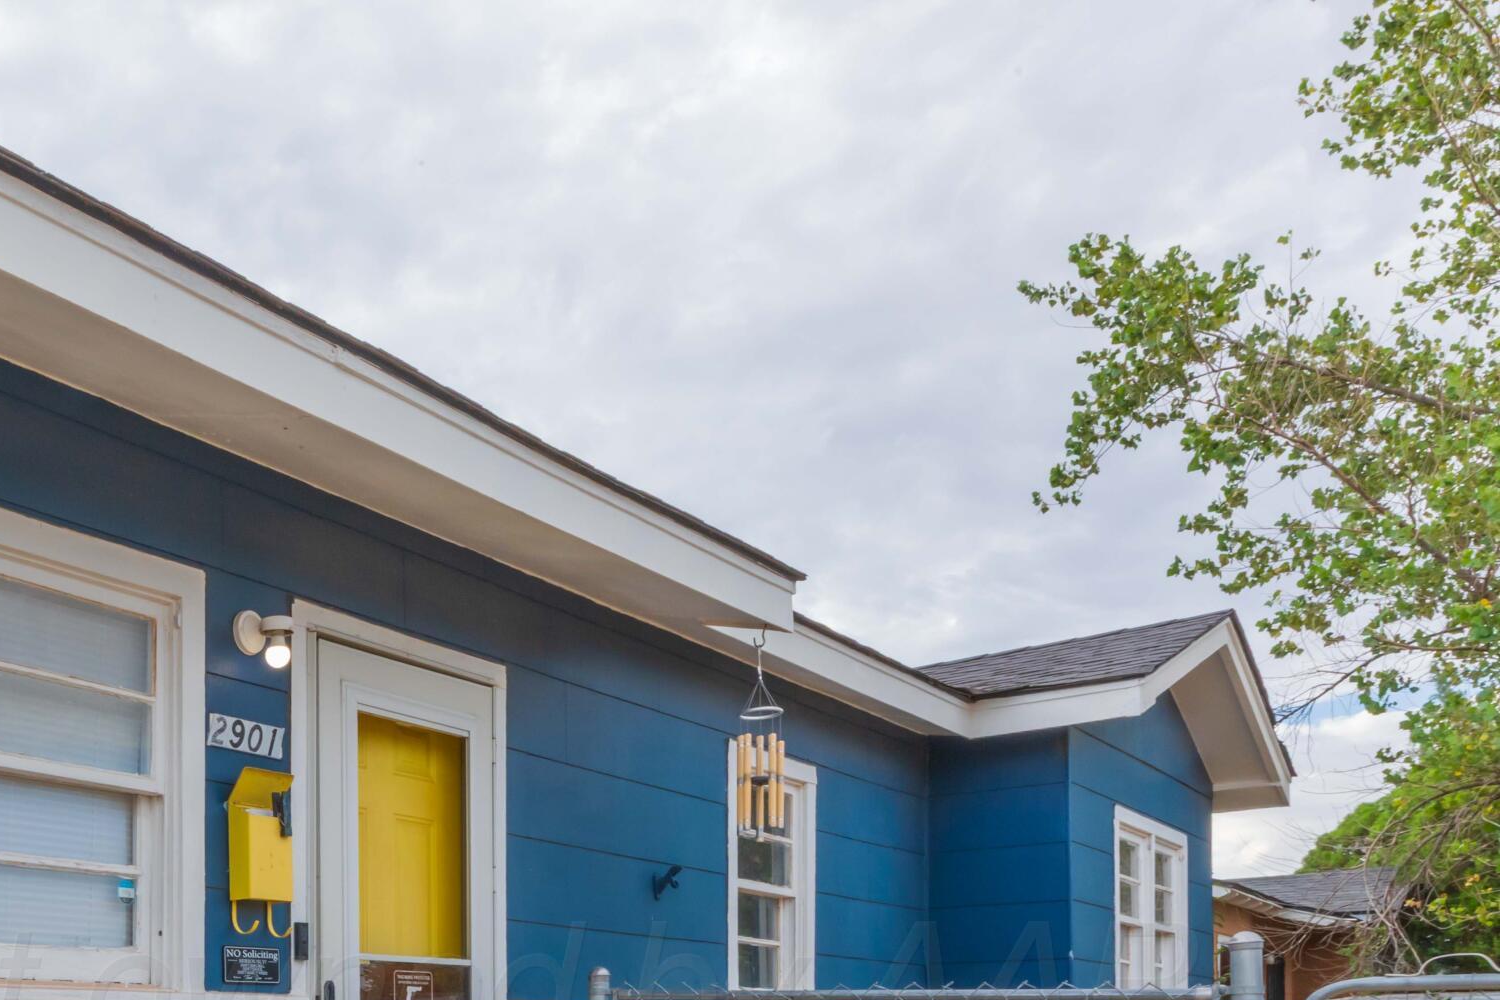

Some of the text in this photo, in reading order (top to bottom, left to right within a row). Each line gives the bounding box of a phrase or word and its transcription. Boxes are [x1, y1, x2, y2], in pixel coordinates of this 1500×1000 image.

[211, 716, 278, 756] 2901
[226, 948, 241, 958] NO
[242, 949, 278, 962] Soliciting
